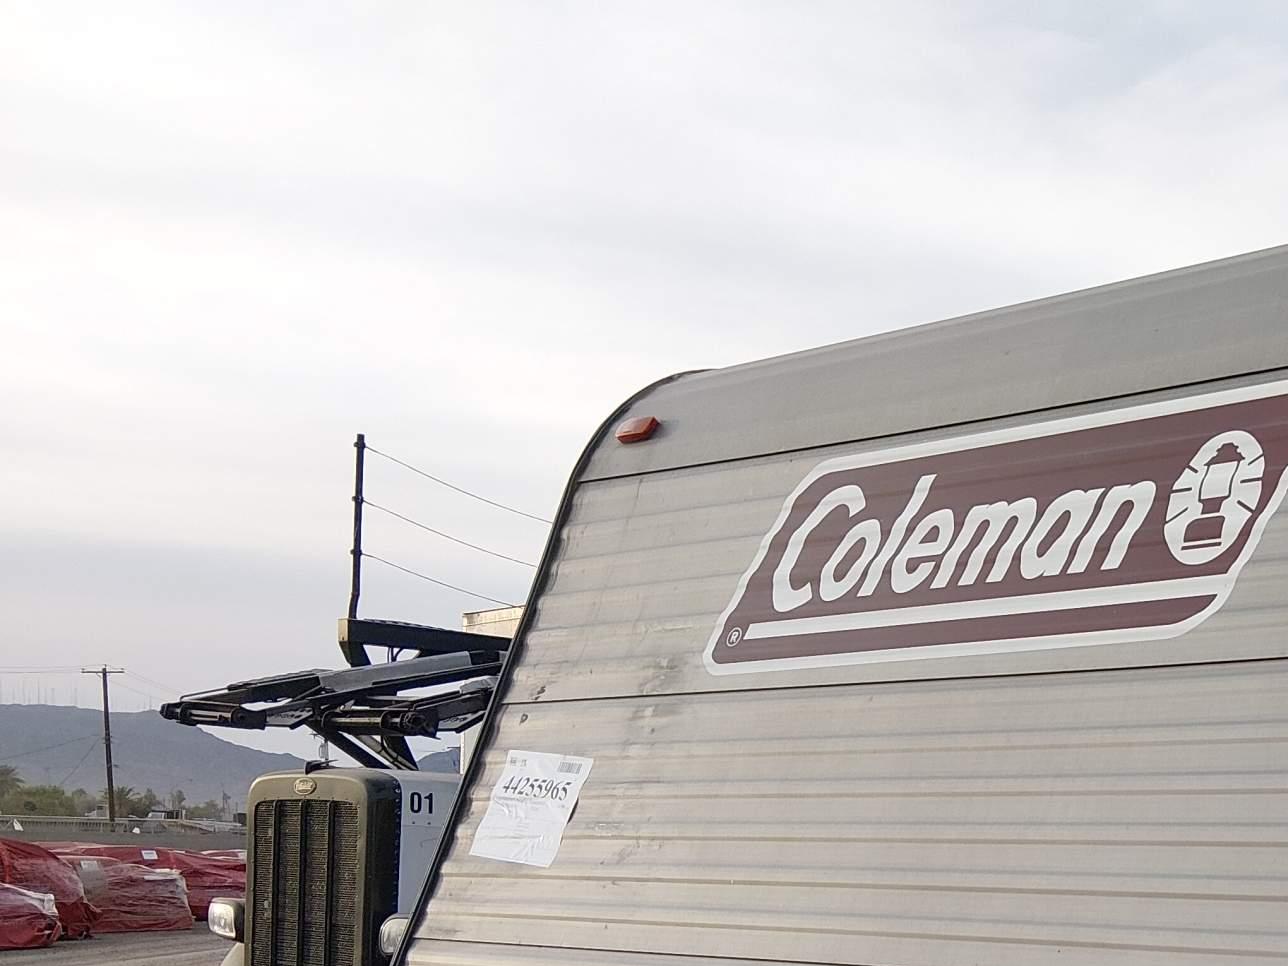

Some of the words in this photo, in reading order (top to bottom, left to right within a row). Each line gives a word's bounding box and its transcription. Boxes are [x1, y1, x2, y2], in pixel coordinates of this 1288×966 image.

[772, 474, 1157, 613] Coleman
[502, 775, 572, 801] 44255965
[409, 791, 434, 815] 01
